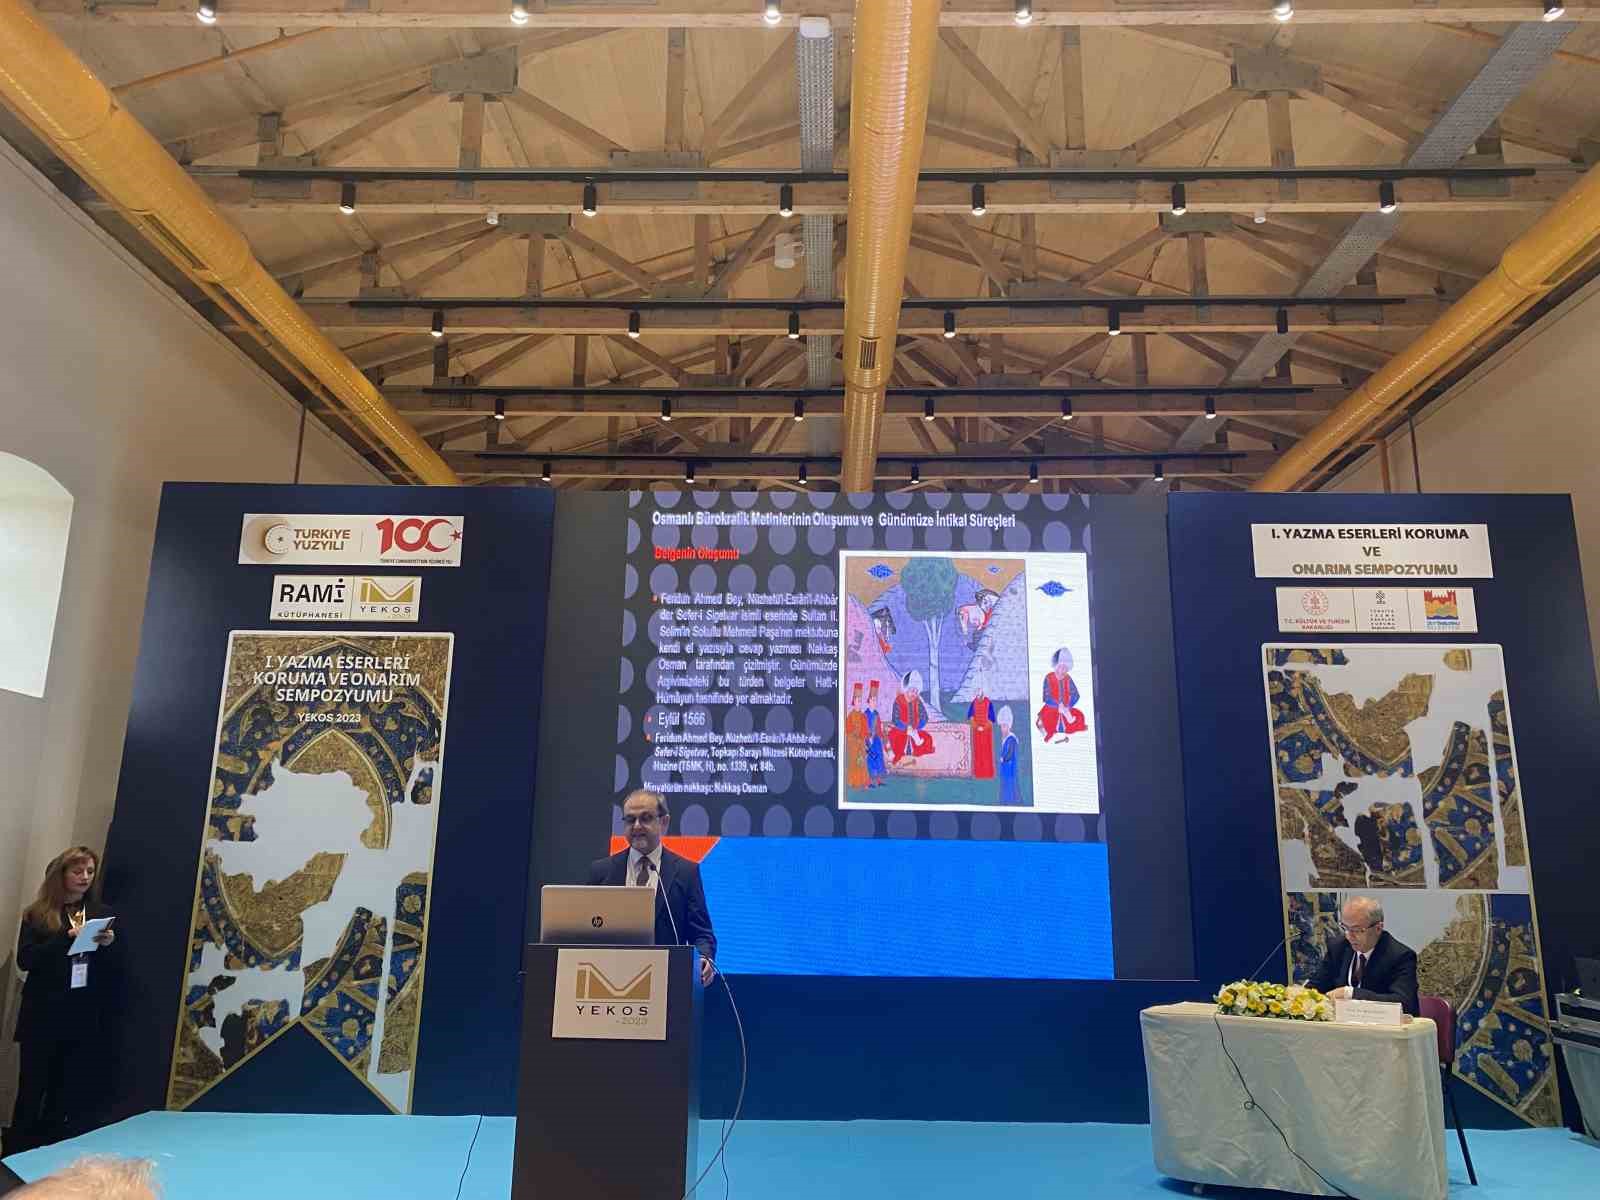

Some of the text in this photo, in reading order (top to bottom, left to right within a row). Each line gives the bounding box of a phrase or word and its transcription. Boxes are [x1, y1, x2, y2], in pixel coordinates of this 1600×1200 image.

[652, 510, 1016, 530] Osmanlı Bürokratik Metinlerinin Oluşumu ve Günümüze İntikal Süreçleri
[294, 528, 351, 539] TÜRKİYE
[1271, 526, 1469, 539] I. YAZMA ESERLERİ KORUMA
[293, 540, 345, 551] YÜZYILI
[1362, 546, 1381, 557] VE
[1292, 564, 1458, 575] ONARIM SEMPOZYUMU
[360, 606, 411, 614] YEKOS
[686, 642, 694, 654] el
[276, 656, 334, 669] YAZMA
[336, 654, 410, 670] ESERLERİ
[658, 659, 686, 670] Osman
[790, 659, 838, 670] Günümüzde
[253, 672, 421, 686] KORUMA VE ONARIM
[718, 675, 730, 688] bu
[774, 676, 806, 690] belgeler
[276, 688, 394, 702] SEMPOZYUMU
[736, 694, 749, 706] yer
[298, 712, 361, 723] YEKOS 2023
[658, 712, 706, 728] Eylül 1566
[576, 1006, 648, 1016] YEKOS
